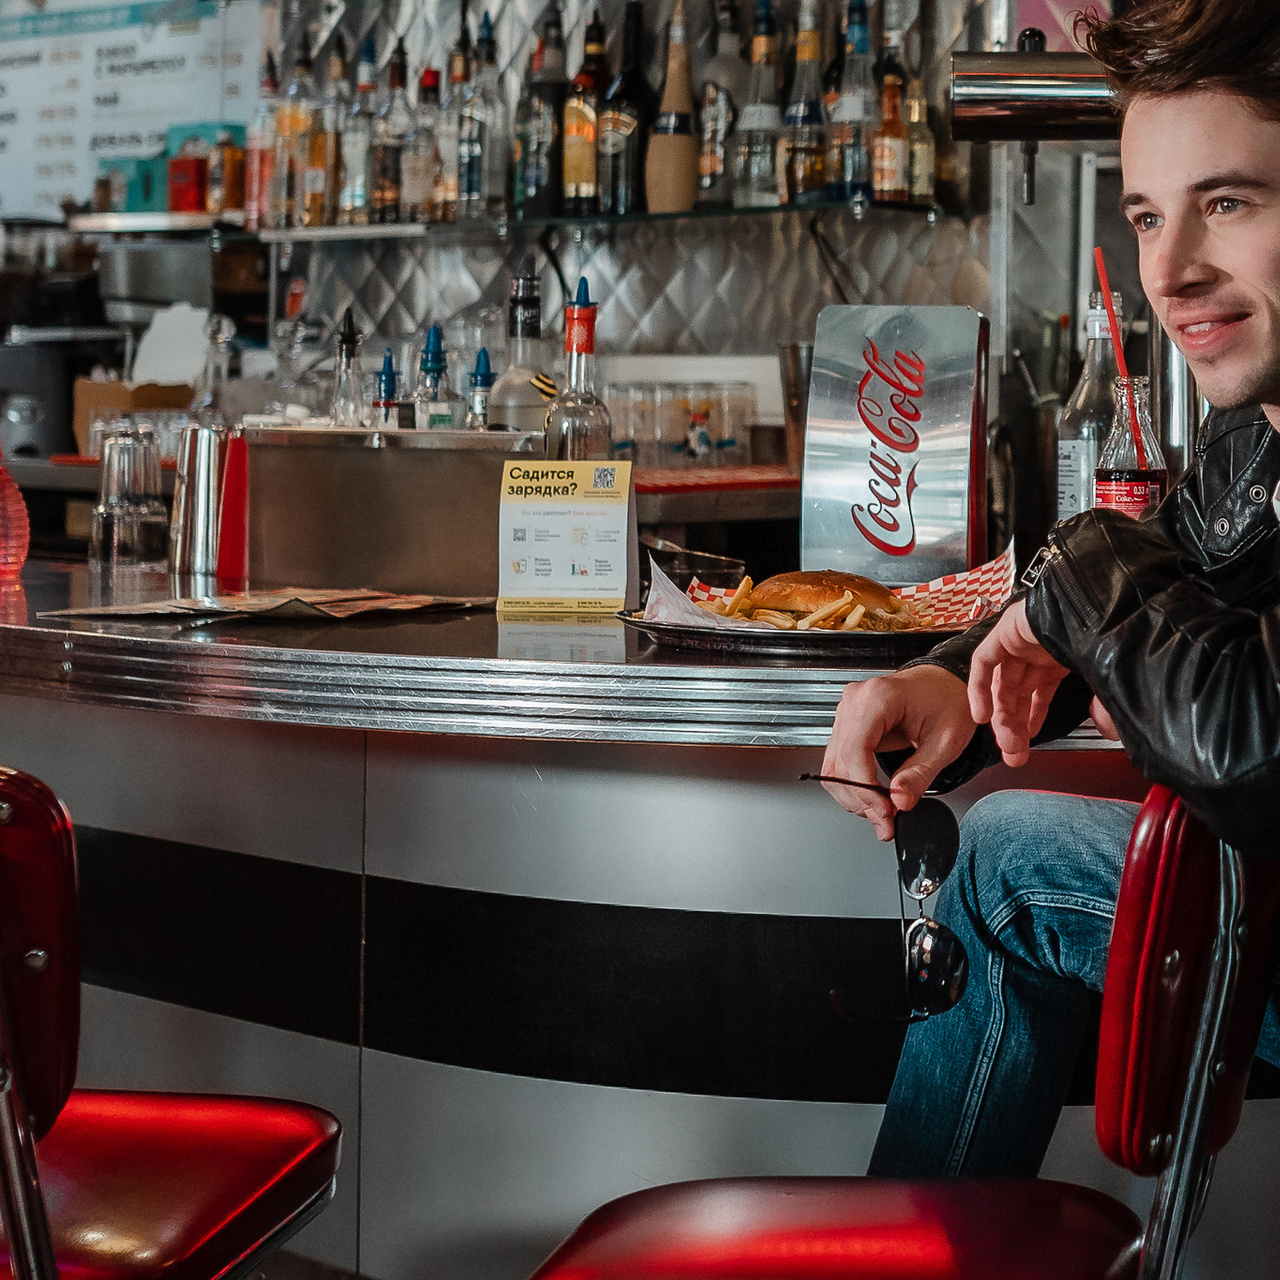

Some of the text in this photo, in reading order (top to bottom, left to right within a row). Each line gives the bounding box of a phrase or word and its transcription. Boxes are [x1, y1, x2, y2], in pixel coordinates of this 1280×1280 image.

[851, 336, 927, 557] Coca-Cola
[509, 467, 574, 481] Садится
[508, 483, 577, 498] зарядка?
